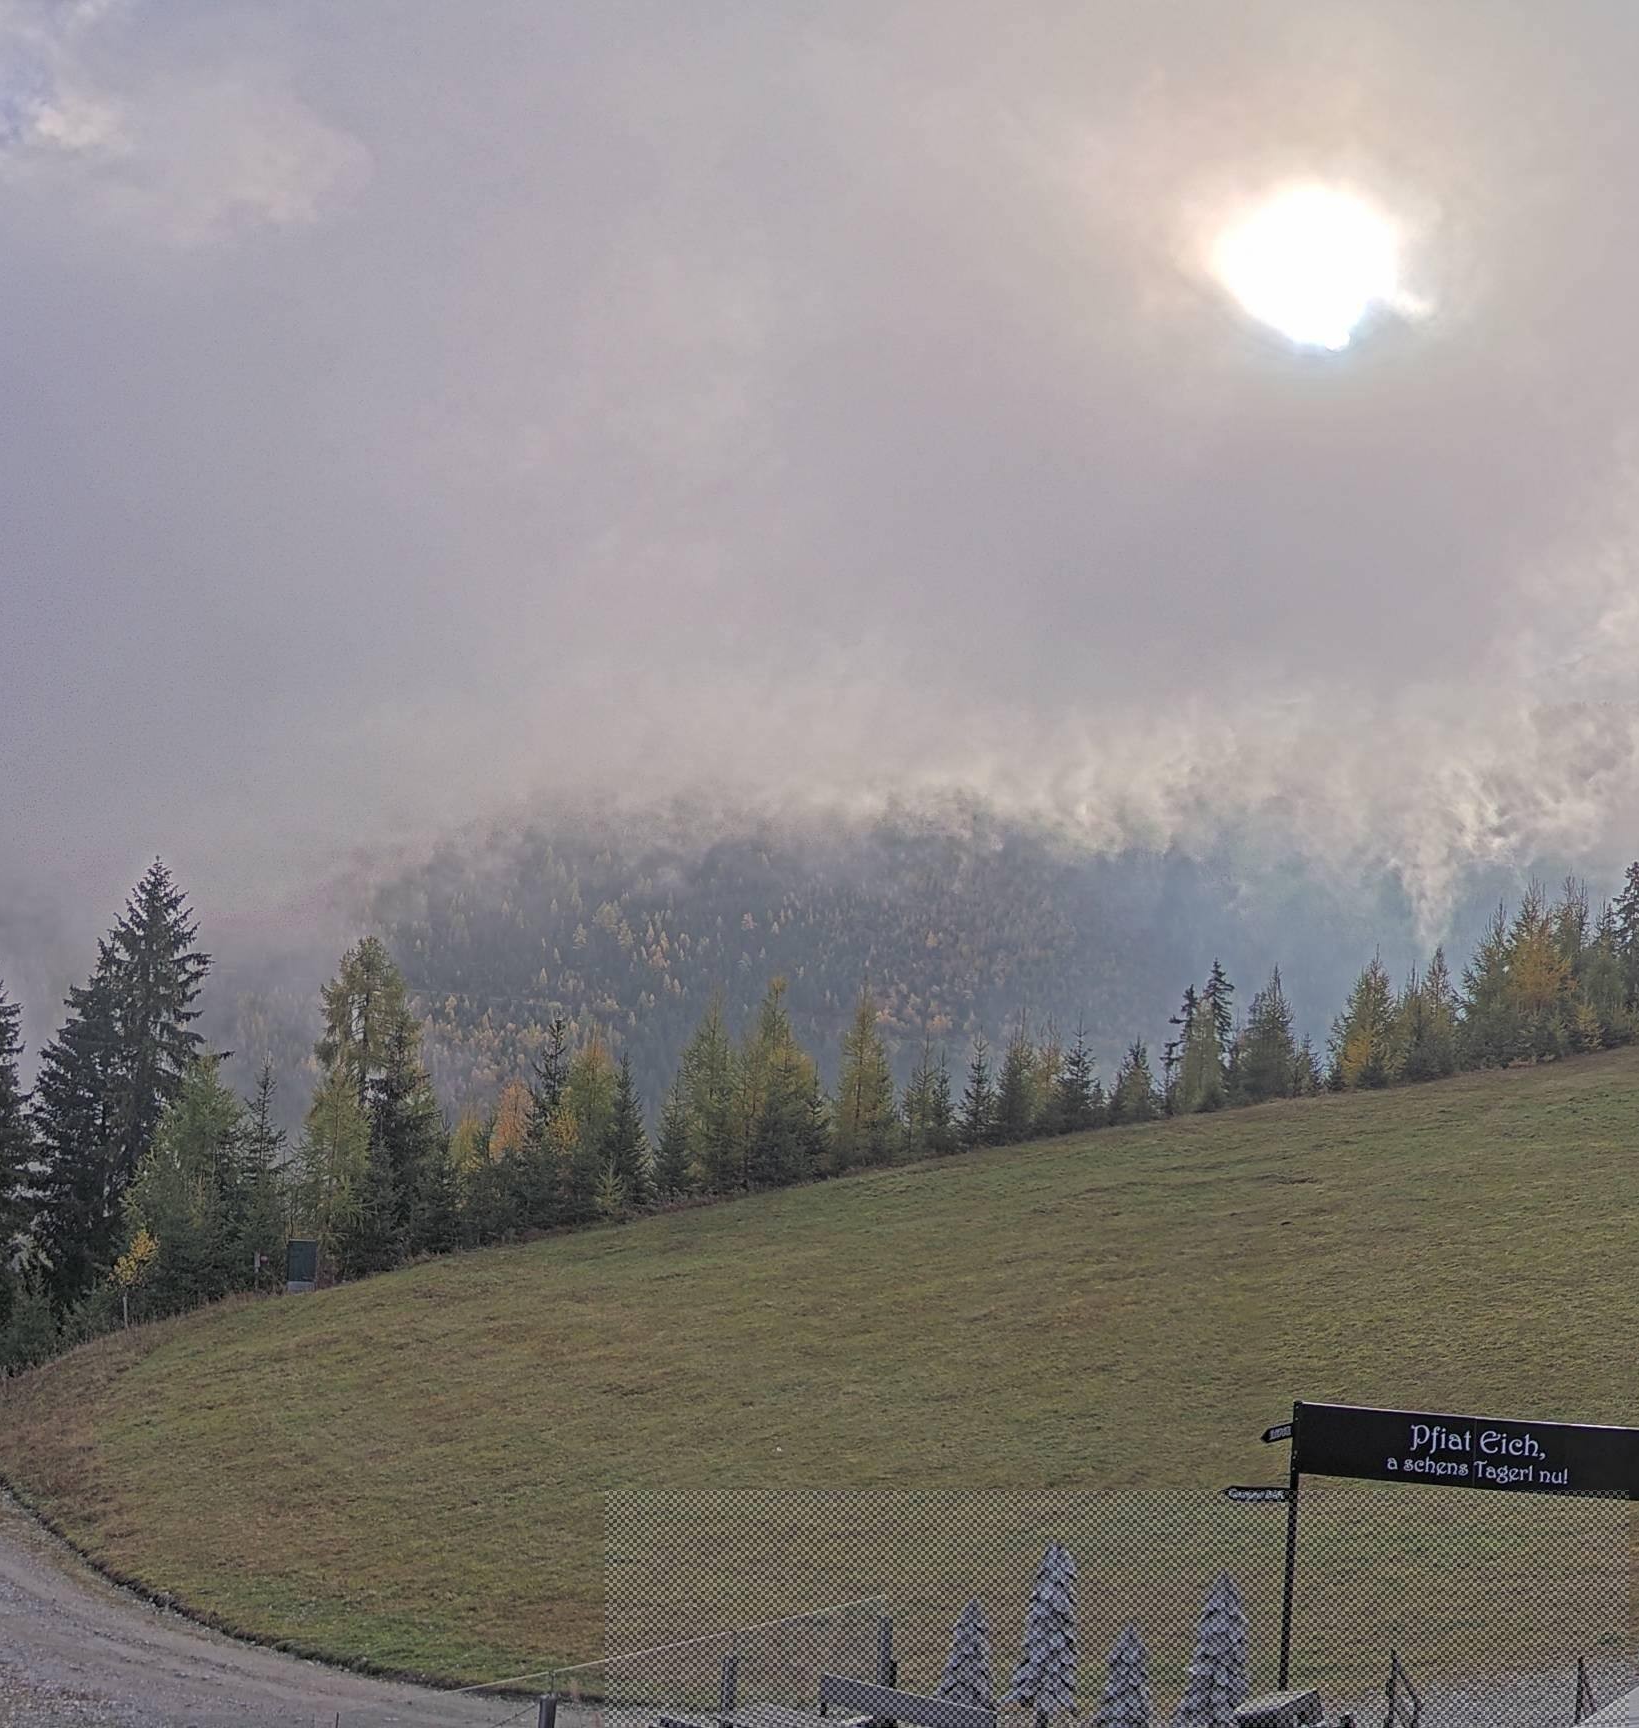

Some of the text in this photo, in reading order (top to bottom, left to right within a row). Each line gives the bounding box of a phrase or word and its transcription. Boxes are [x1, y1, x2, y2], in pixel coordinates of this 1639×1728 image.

[1410, 1424, 1547, 1461] Pfiat Eich,
[1387, 1456, 1569, 1485] a schens Tagerl nu!
